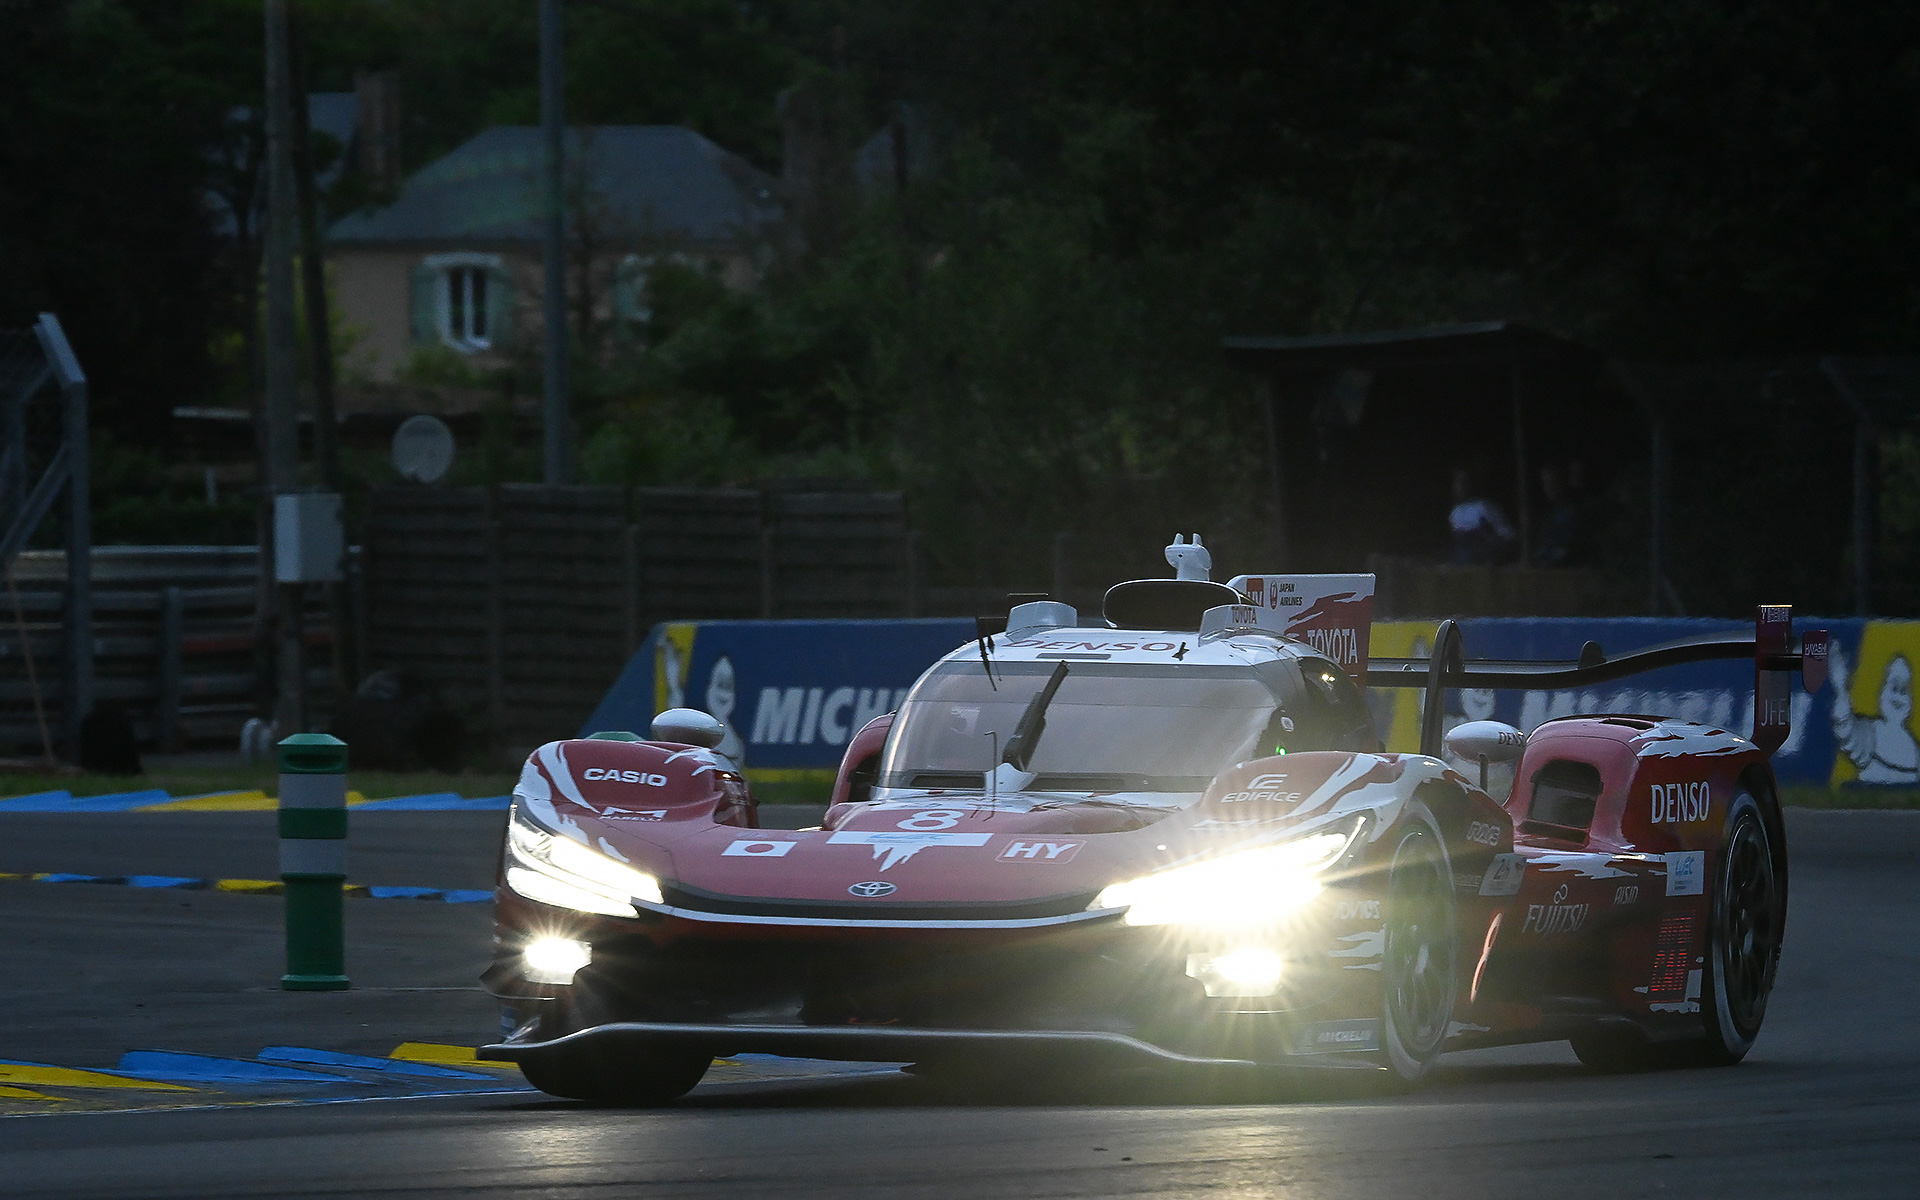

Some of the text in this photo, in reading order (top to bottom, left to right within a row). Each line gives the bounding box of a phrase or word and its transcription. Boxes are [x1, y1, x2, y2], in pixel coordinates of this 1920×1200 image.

[1279, 583, 1295, 593] JAPAN
[1279, 596, 1303, 606] AIRLINES
[1231, 606, 1257, 624] TOYOTA
[1006, 639, 1176, 651] DENSO
[1307, 628, 1359, 665] TOYOTA
[583, 768, 668, 787] CASIO
[1220, 791, 1301, 803] EDIFICE
[1650, 781, 1710, 824] DENSO
[899, 809, 966, 832] 8
[1003, 842, 1078, 860] HY
[1521, 903, 1589, 936] FUJITSU
